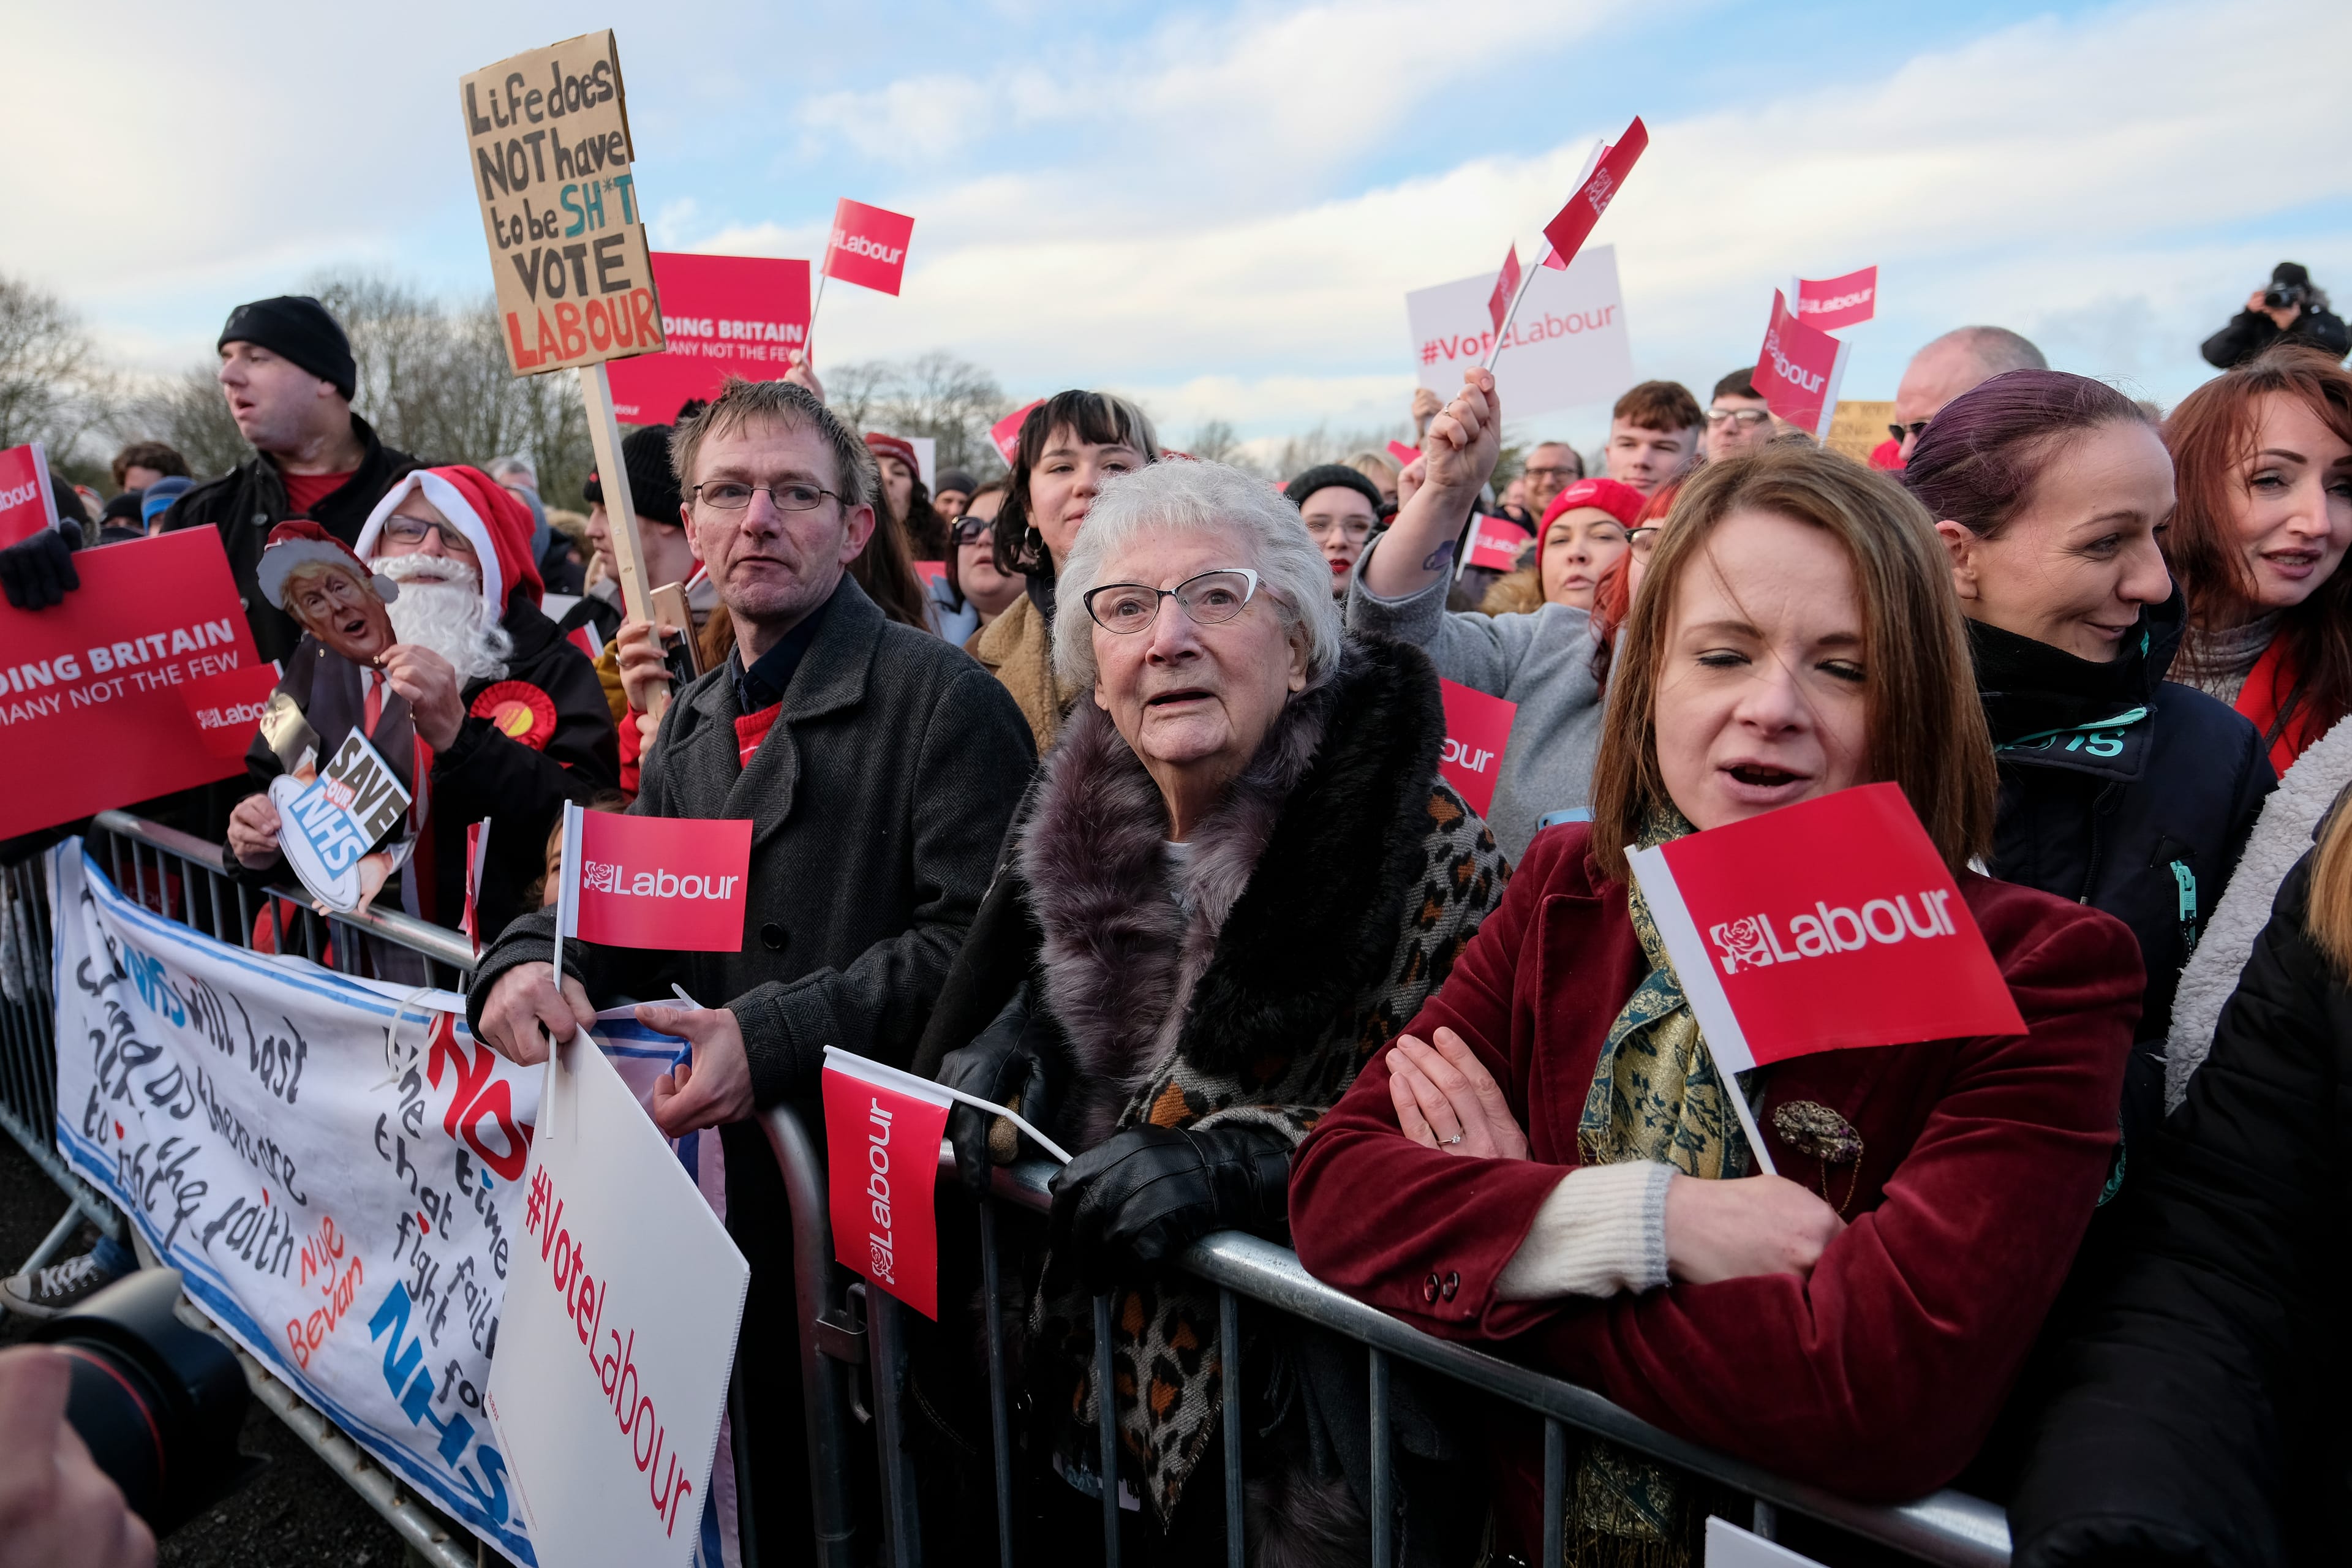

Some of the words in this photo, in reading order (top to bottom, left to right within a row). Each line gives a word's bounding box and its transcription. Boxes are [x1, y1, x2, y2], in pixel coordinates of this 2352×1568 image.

[466, 72, 544, 137] Life
[548, 60, 613, 118] does
[477, 129, 546, 201] NOT
[550, 127, 625, 181] have
[491, 206, 523, 249] to
[523, 197, 559, 241] be
[838, 230, 903, 265] Labour
[511, 233, 631, 304] VOTE
[506, 287, 662, 370] LABOUR
[703, 341, 734, 358] NOT
[737, 344, 768, 361] THE
[718, 320, 803, 342] BRITAIN
[69, 677, 124, 709] NOT
[130, 664, 184, 693] THE
[187, 650, 239, 680] FEW
[88, 618, 235, 674] BRITAIN
[214, 701, 268, 726] Labo
[292, 784, 365, 871] NHS
[327, 737, 409, 842] SAVE
[327, 782, 352, 807] OUR
[613, 864, 739, 900] Labour
[1757, 888, 1956, 964] Labour
[172, 974, 234, 1057] will
[229, 992, 307, 1104] last
[426, 1011, 535, 1182] NO
[374, 1112, 453, 1242] that
[867, 1097, 893, 1250] Labour
[202, 1186, 295, 1278] faith
[455, 1148, 508, 1281] time
[300, 1215, 344, 1296] Nye
[393, 1210, 450, 1348] fight
[286, 1256, 364, 1370] Bevan
[526, 1163, 692, 1539] #VoteLabour
[368, 1279, 511, 1525] NHS
